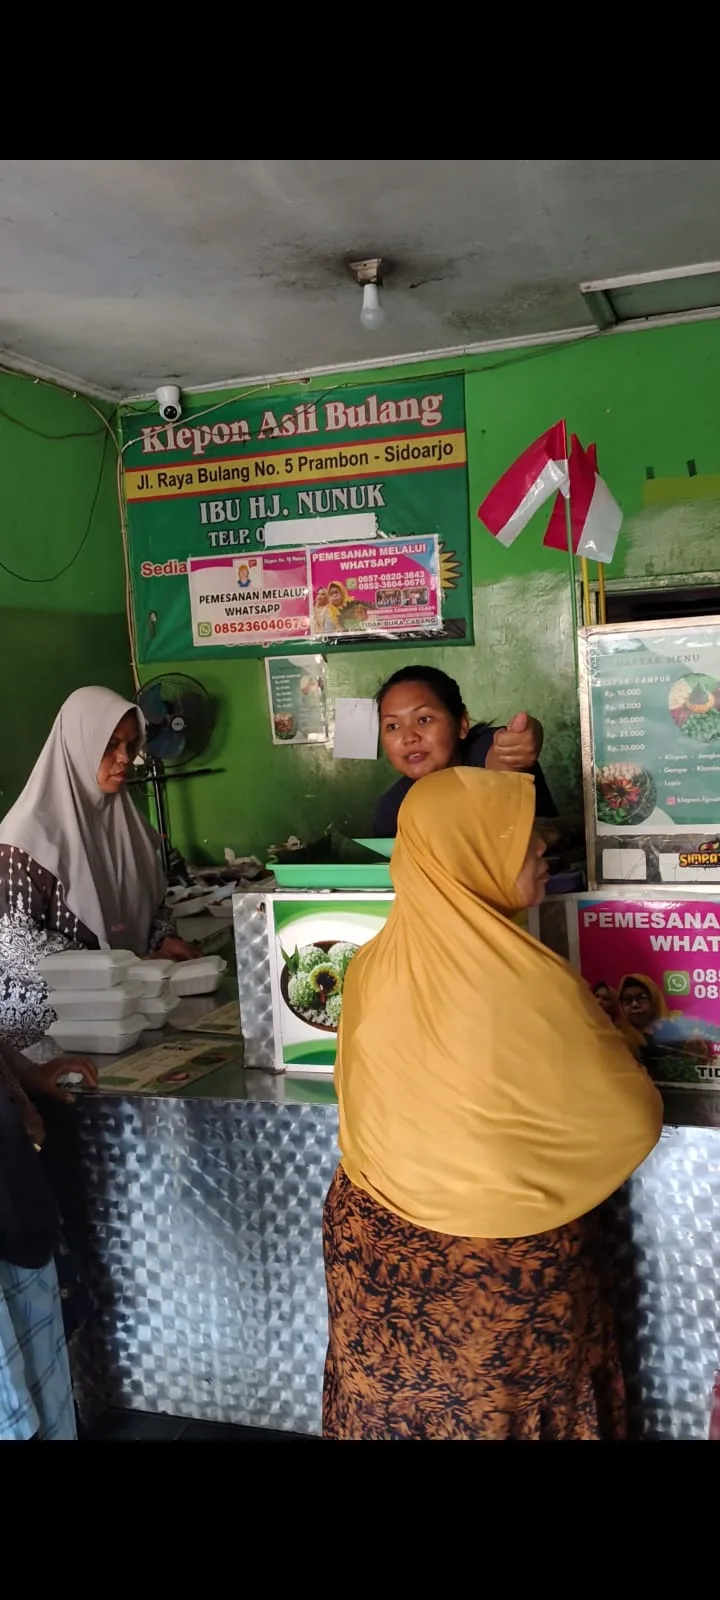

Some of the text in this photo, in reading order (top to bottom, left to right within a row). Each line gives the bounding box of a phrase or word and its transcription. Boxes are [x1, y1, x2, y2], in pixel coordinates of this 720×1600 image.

[140, 394, 443, 454] Klepon Asli Bulang
[137, 475, 154, 490] Jl.
[158, 468, 193, 489] Raya
[198, 462, 250, 483] Bulang
[255, 460, 279, 476] No.
[285, 459, 293, 473] 5
[298, 449, 368, 472] Prambon
[385, 441, 453, 464] Sidoarjo
[200, 484, 385, 524] IBU HJ. NUNUK
[208, 530, 250, 547] TELP.
[312, 544, 426, 562] PEMESANAN MELALUI
[141, 562, 187, 577] Sedia
[340, 558, 398, 570] WHATSAPP
[199, 591, 259, 604] PEMESANAN
[225, 604, 280, 616] WHATSAPP
[666, 654, 700, 663] MENU
[635, 676, 671, 684] CAMPUR
[693, 969, 720, 983] 08
[694, 985, 720, 999] 08
